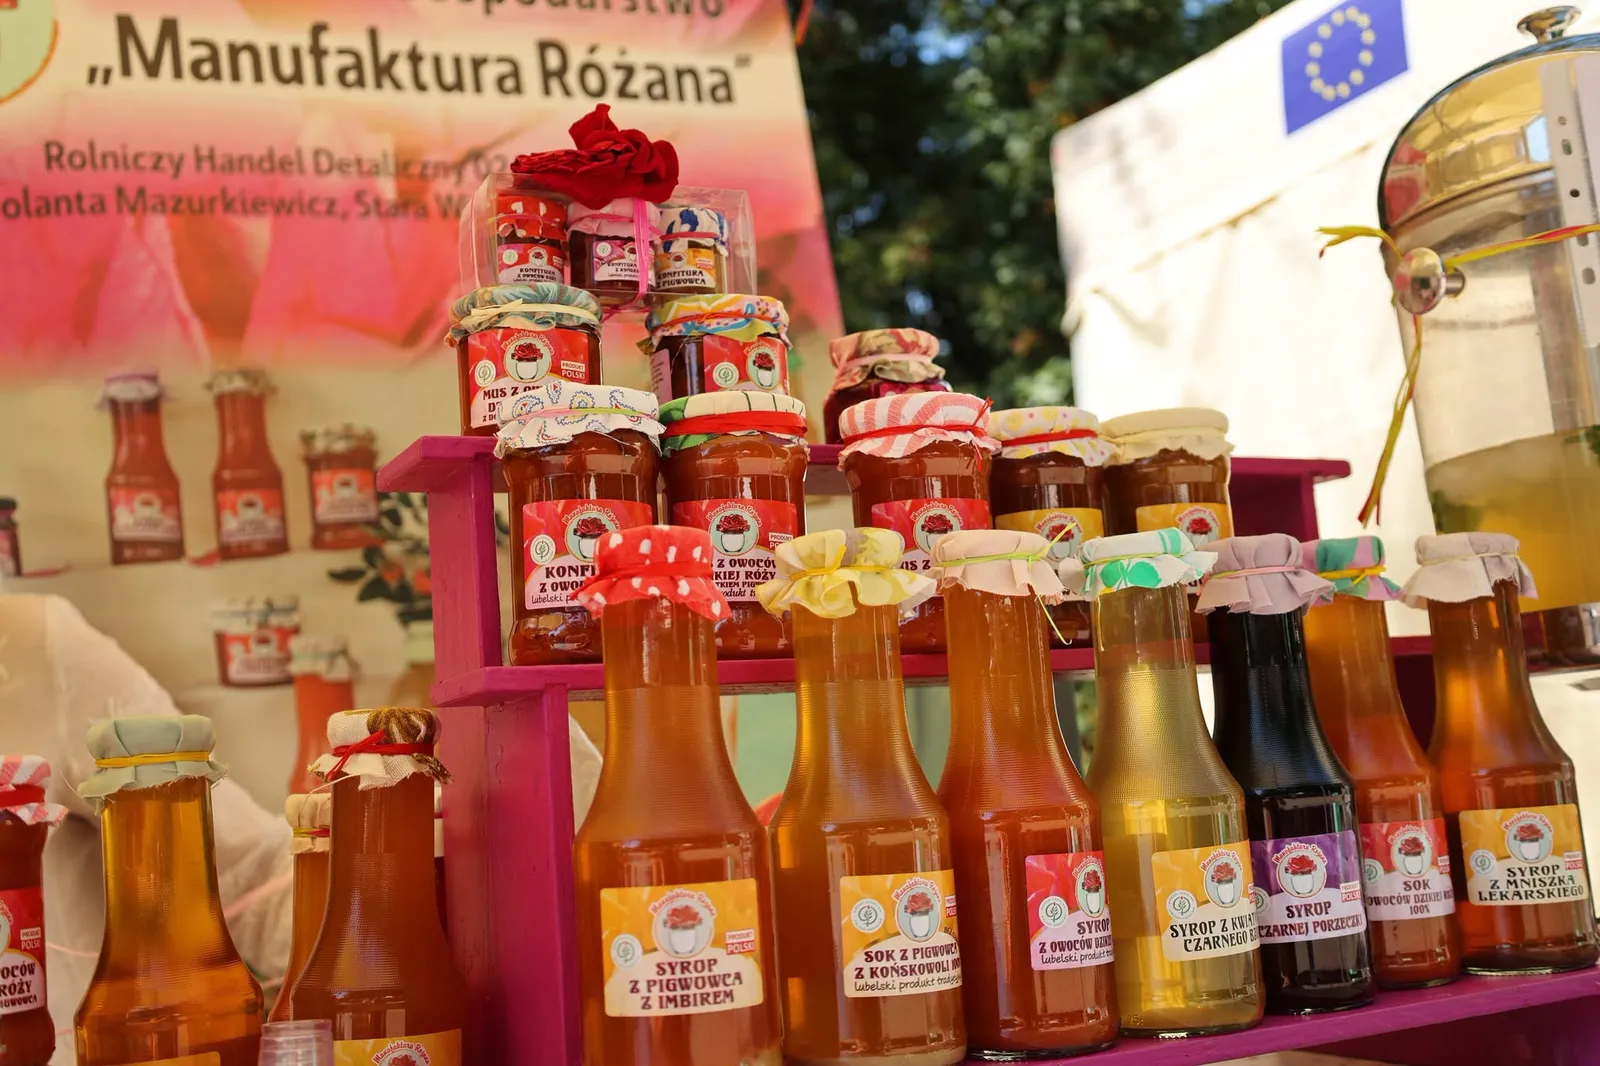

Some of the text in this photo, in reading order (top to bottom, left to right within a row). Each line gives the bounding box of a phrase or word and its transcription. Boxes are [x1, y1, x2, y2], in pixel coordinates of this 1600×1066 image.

[44, 139, 184, 179] Rolniczy
[193, 144, 305, 176] Handel
[562, 370, 585, 379] POLSKI
[483, 386, 507, 400] MUS
[511, 386, 519, 396] Z
[717, 558, 725, 568] Z
[745, 569, 776, 580] RÓŻY
[539, 583, 547, 593] Z
[531, 593, 563, 604] lubelski
[1507, 864, 1560, 878] SYROP
[1403, 879, 1431, 891] SOK
[1489, 874, 1575, 890] Z MNISZKA
[1367, 892, 1411, 906] OWOCÓW
[1478, 885, 1584, 901] LEKARSKIEGO
[1285, 901, 1332, 918] SYROP
[1077, 918, 1110, 935] SYROP
[1170, 920, 1216, 938] SYROP
[1220, 919, 1228, 932] Z
[1312, 914, 1363, 934] PORZECZKI
[727, 941, 755, 954] POLSKI
[1039, 942, 1047, 953] Z
[1051, 935, 1093, 953] OWOCÓW
[1184, 930, 1248, 953] CZARNEGO
[864, 942, 957, 963] SOK Z PIGWOWCA
[1041, 950, 1078, 964] lubelski
[655, 958, 718, 976] SYROP
[855, 967, 864, 979] Z
[870, 960, 949, 979] KOŃSKOWOLI
[629, 972, 743, 993] Z PIGWOWCA
[854, 980, 896, 991] lubelski
[899, 977, 935, 992] produkt
[641, 989, 735, 1009] Z IMBIREM
